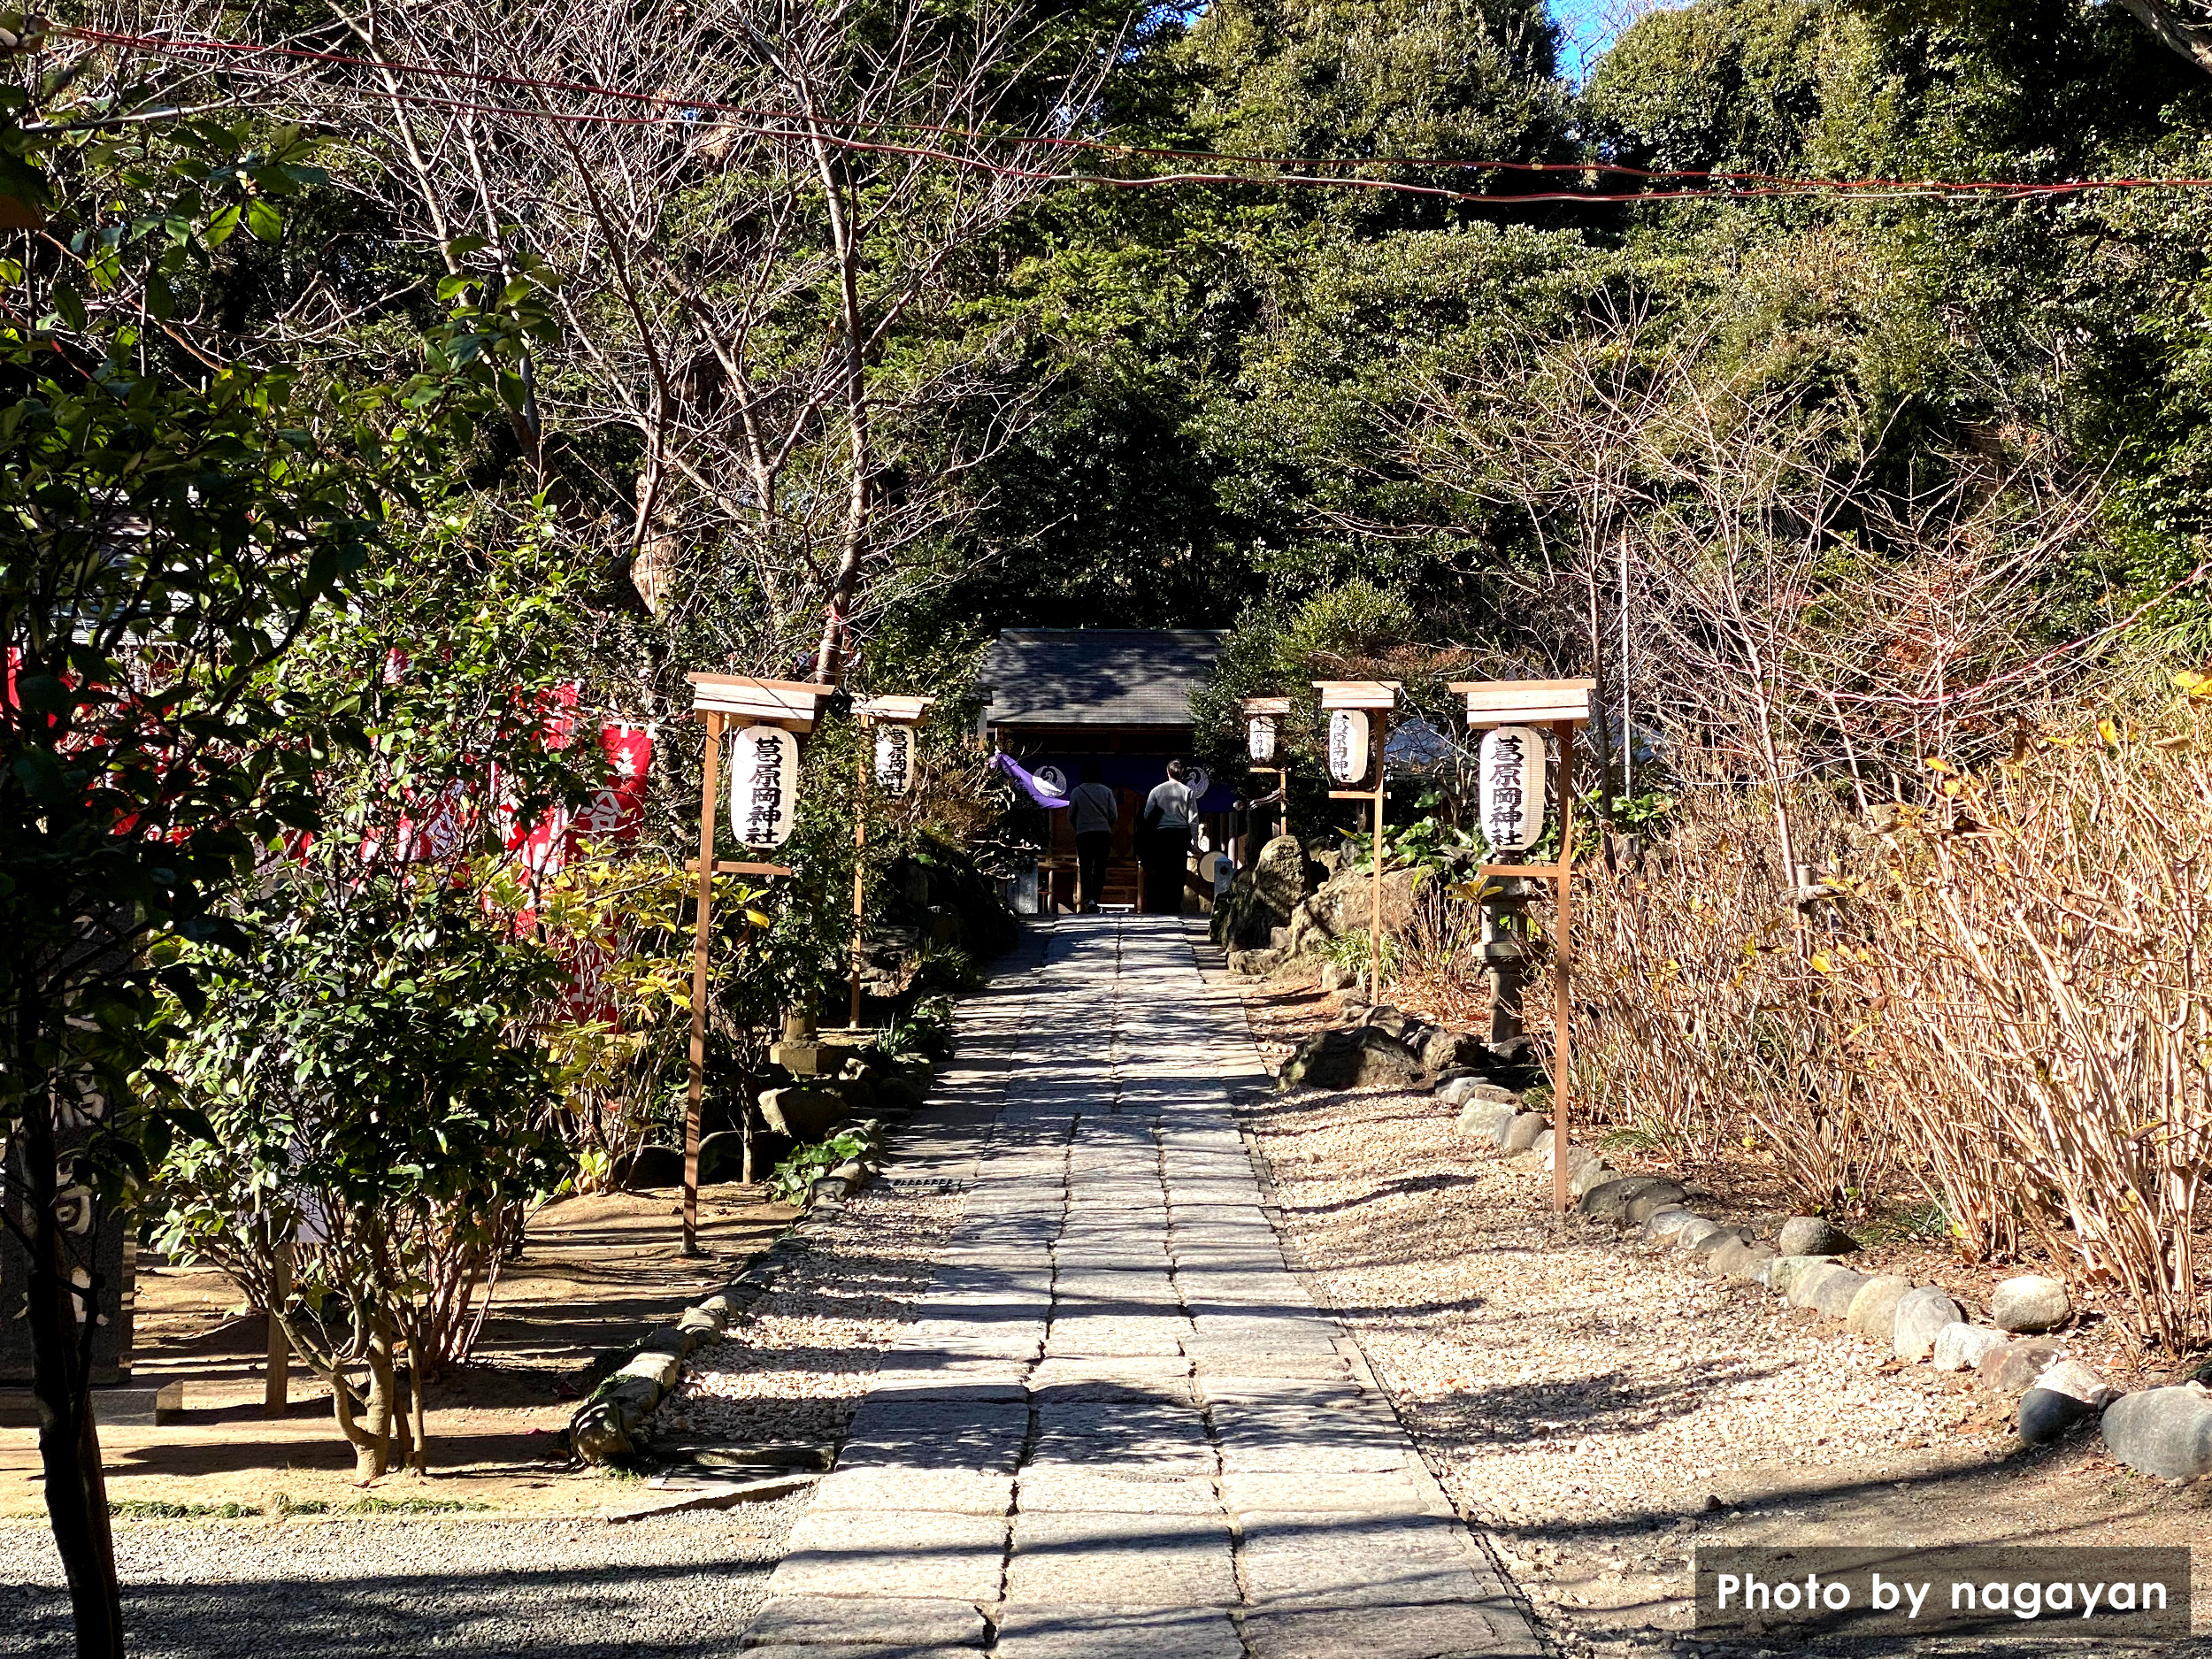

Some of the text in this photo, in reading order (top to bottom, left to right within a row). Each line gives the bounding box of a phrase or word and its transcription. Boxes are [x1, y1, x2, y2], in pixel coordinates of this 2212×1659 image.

[744, 735, 784, 846] 葛原岡神社
[1488, 734, 1525, 847] 葛原岡神社
